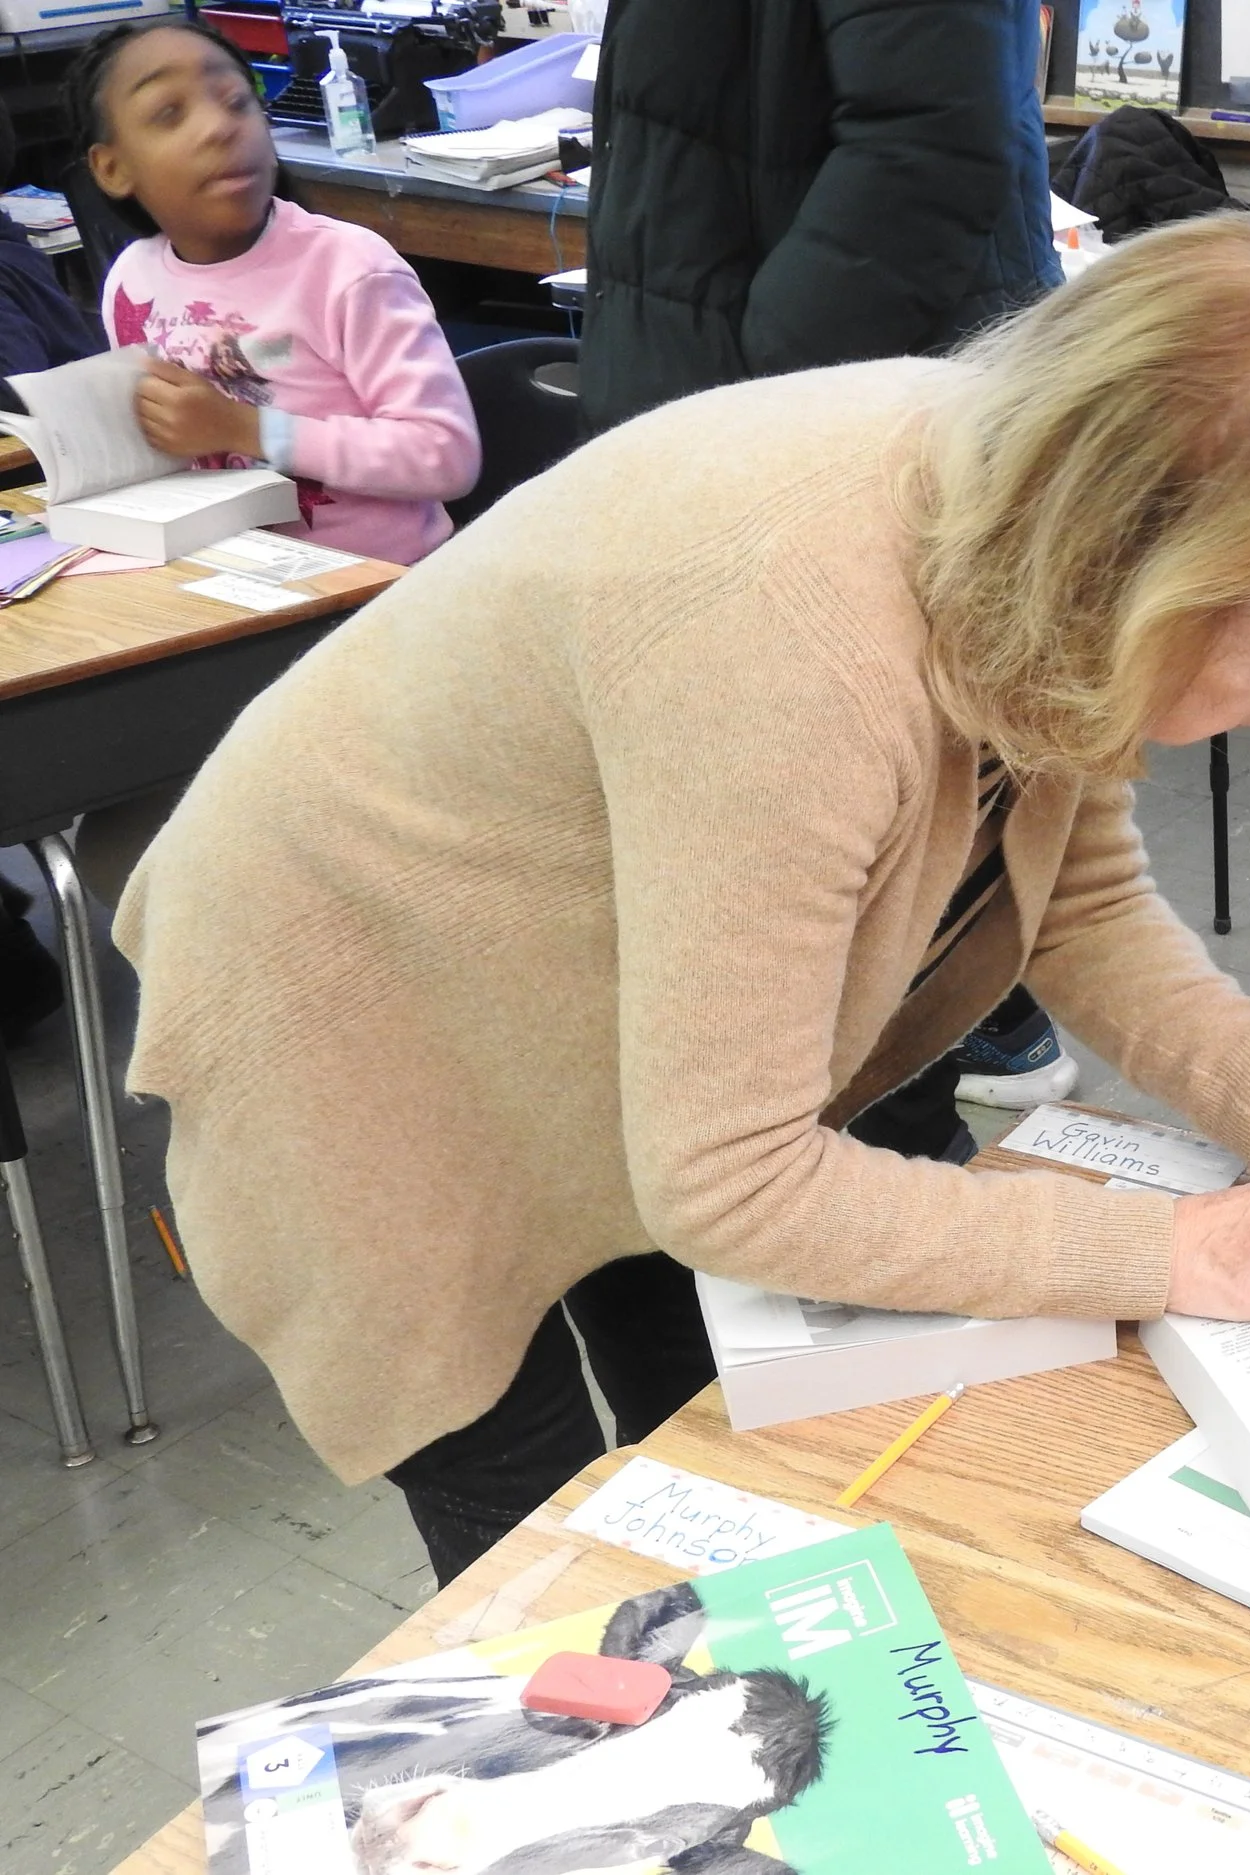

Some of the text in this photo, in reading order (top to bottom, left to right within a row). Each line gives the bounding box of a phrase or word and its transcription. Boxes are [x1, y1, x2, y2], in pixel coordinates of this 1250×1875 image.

[1032, 1130, 1160, 1176] Williams
[1062, 1122, 1140, 1152] Gavin
[641, 1482, 777, 1554] Murphy
[769, 1584, 853, 1661] IM
[889, 1640, 978, 1755] Murphy
